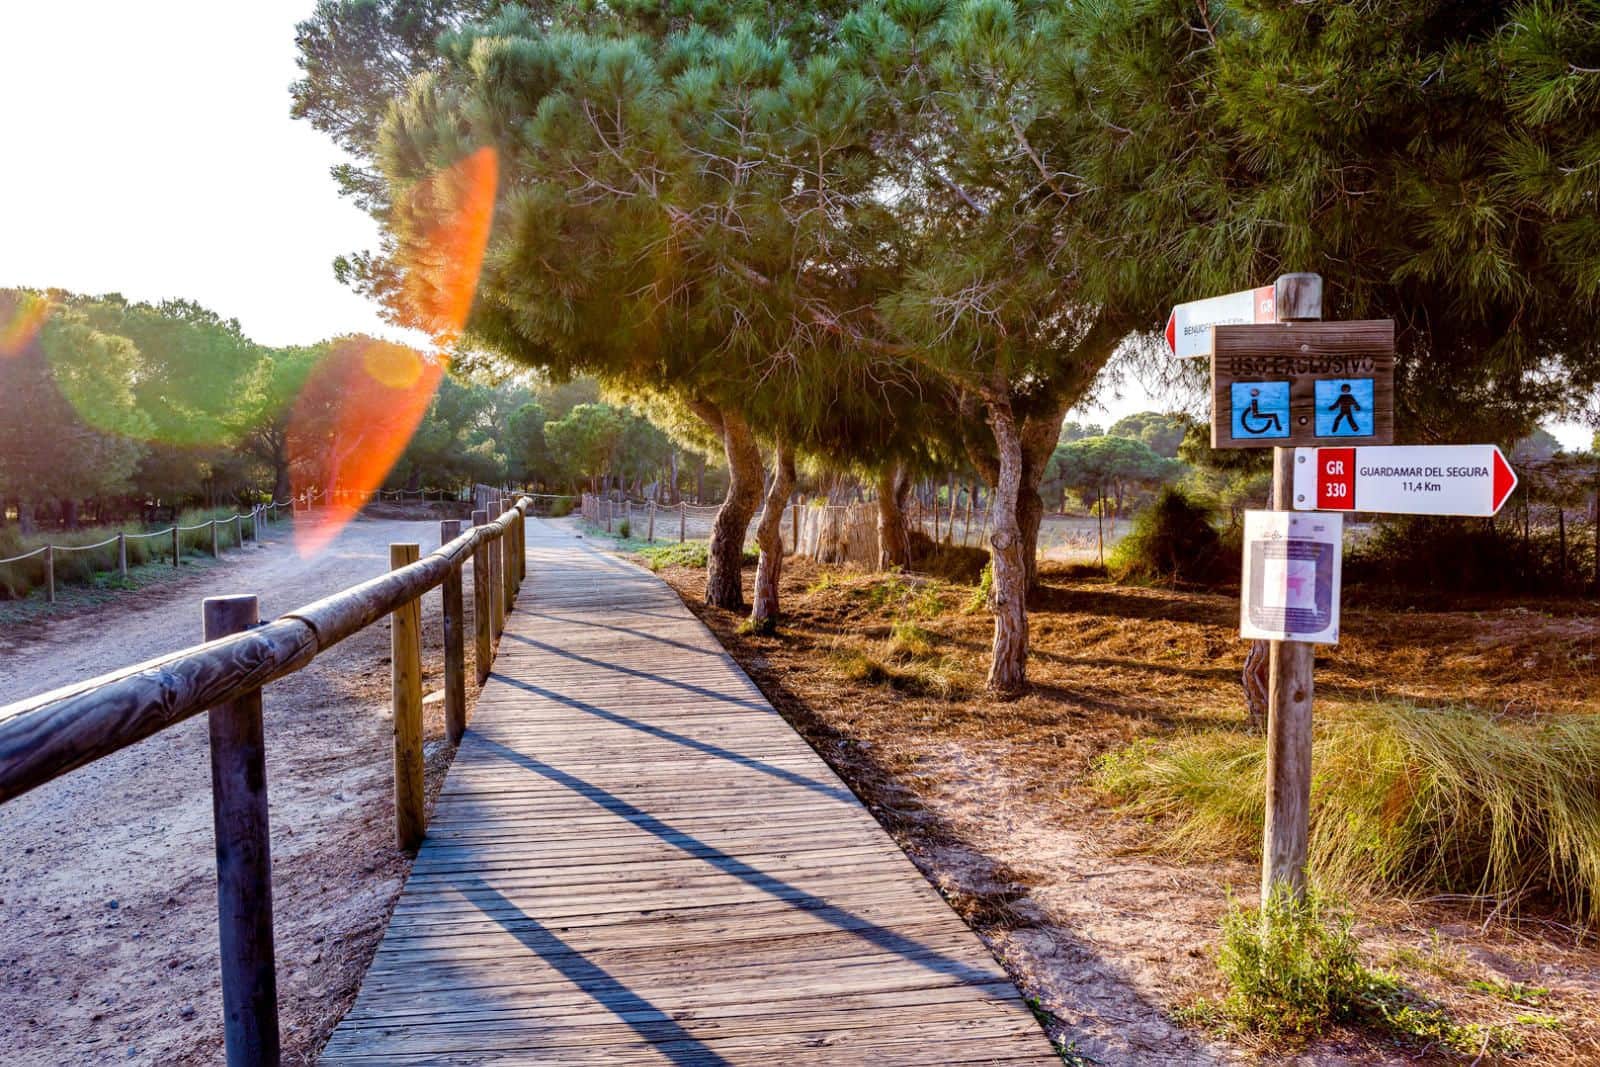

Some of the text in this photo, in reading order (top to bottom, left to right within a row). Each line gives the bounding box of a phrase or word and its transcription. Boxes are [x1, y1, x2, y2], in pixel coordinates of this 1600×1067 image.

[1231, 353, 1375, 376] USO EXCLUSIVO
[1325, 460, 1345, 475] GR
[1359, 466, 1489, 478] GUARDAMAR DEL SEGURA
[1325, 482, 1347, 498] 330
[1402, 481, 1442, 492] 11,4 Km
